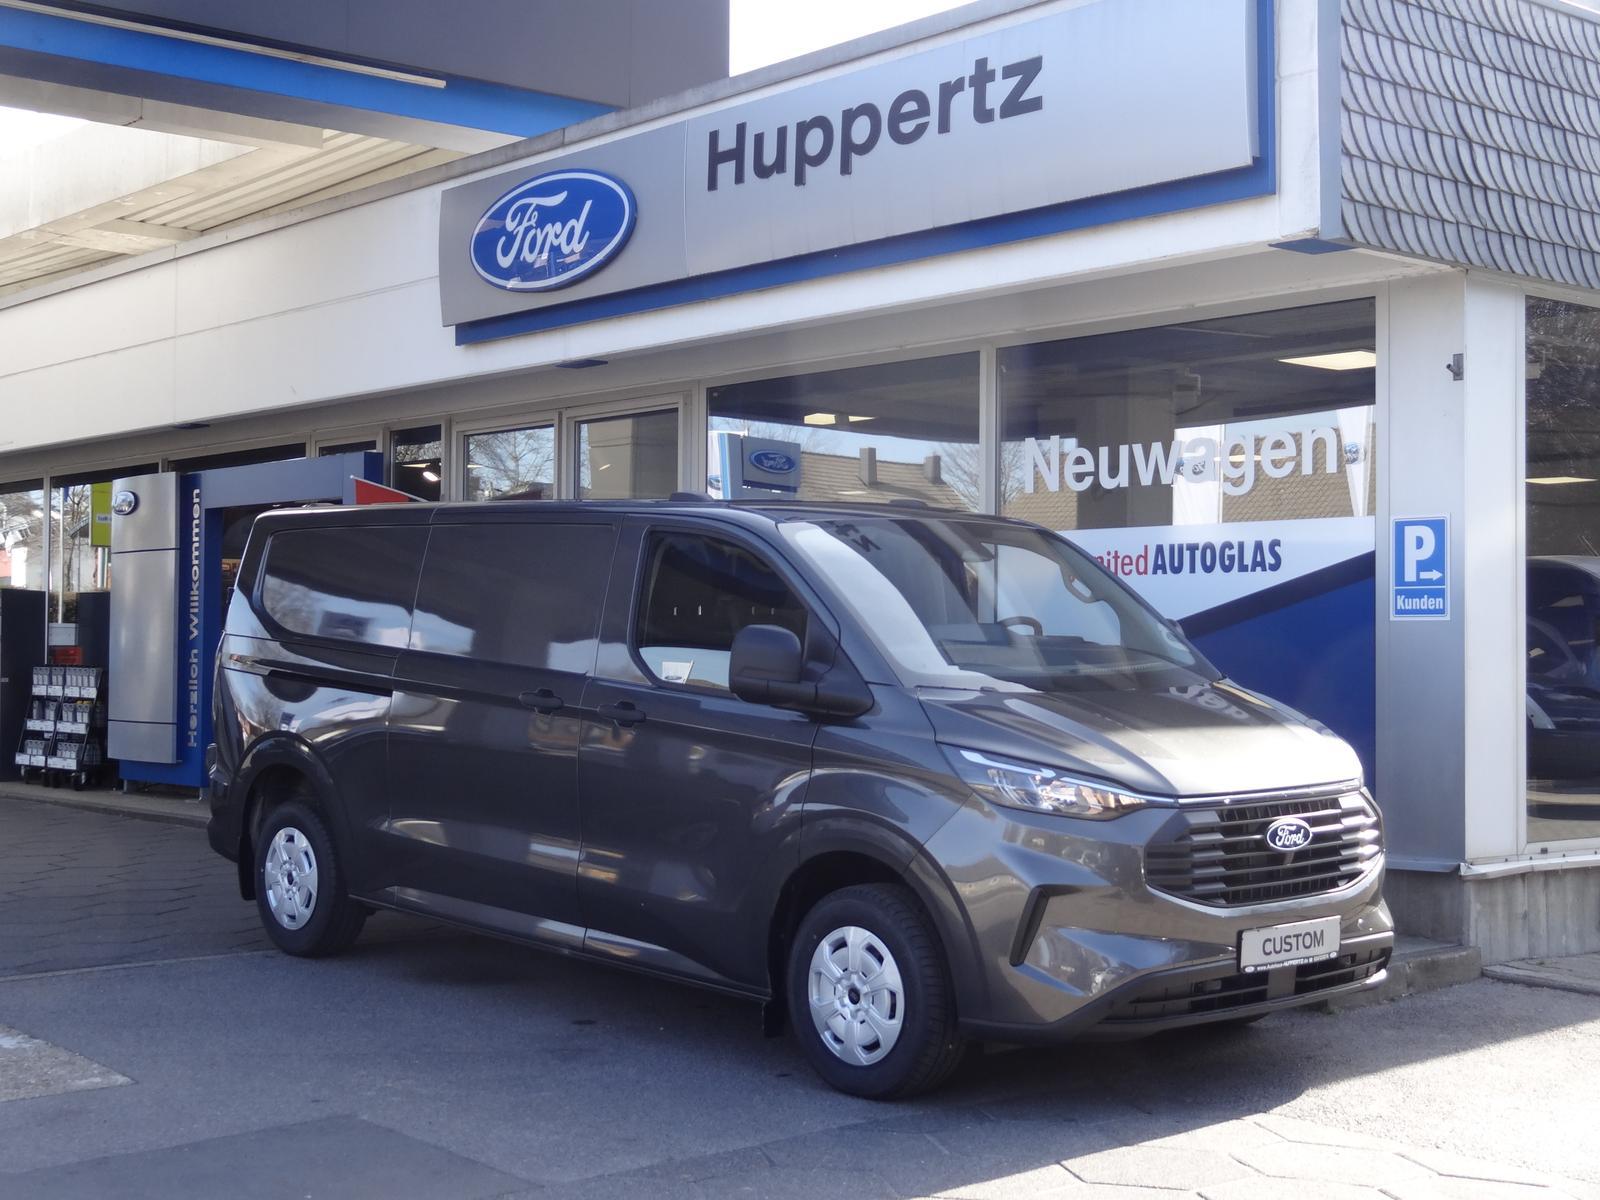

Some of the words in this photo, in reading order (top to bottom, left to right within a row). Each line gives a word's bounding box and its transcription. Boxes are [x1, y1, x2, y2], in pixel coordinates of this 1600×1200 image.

[707, 55, 1043, 192] Huppertz
[496, 190, 593, 269] Ford
[1024, 424, 1338, 497] Neuwagen
[189, 488, 201, 640] Willkommen
[1094, 544, 1148, 577] ited
[1152, 538, 1282, 575] AUTOGLAS
[1404, 525, 1436, 582] P
[1396, 594, 1444, 610] Kunden
[1275, 825, 1305, 847] Ford
[1262, 929, 1324, 956] CUSTOM
